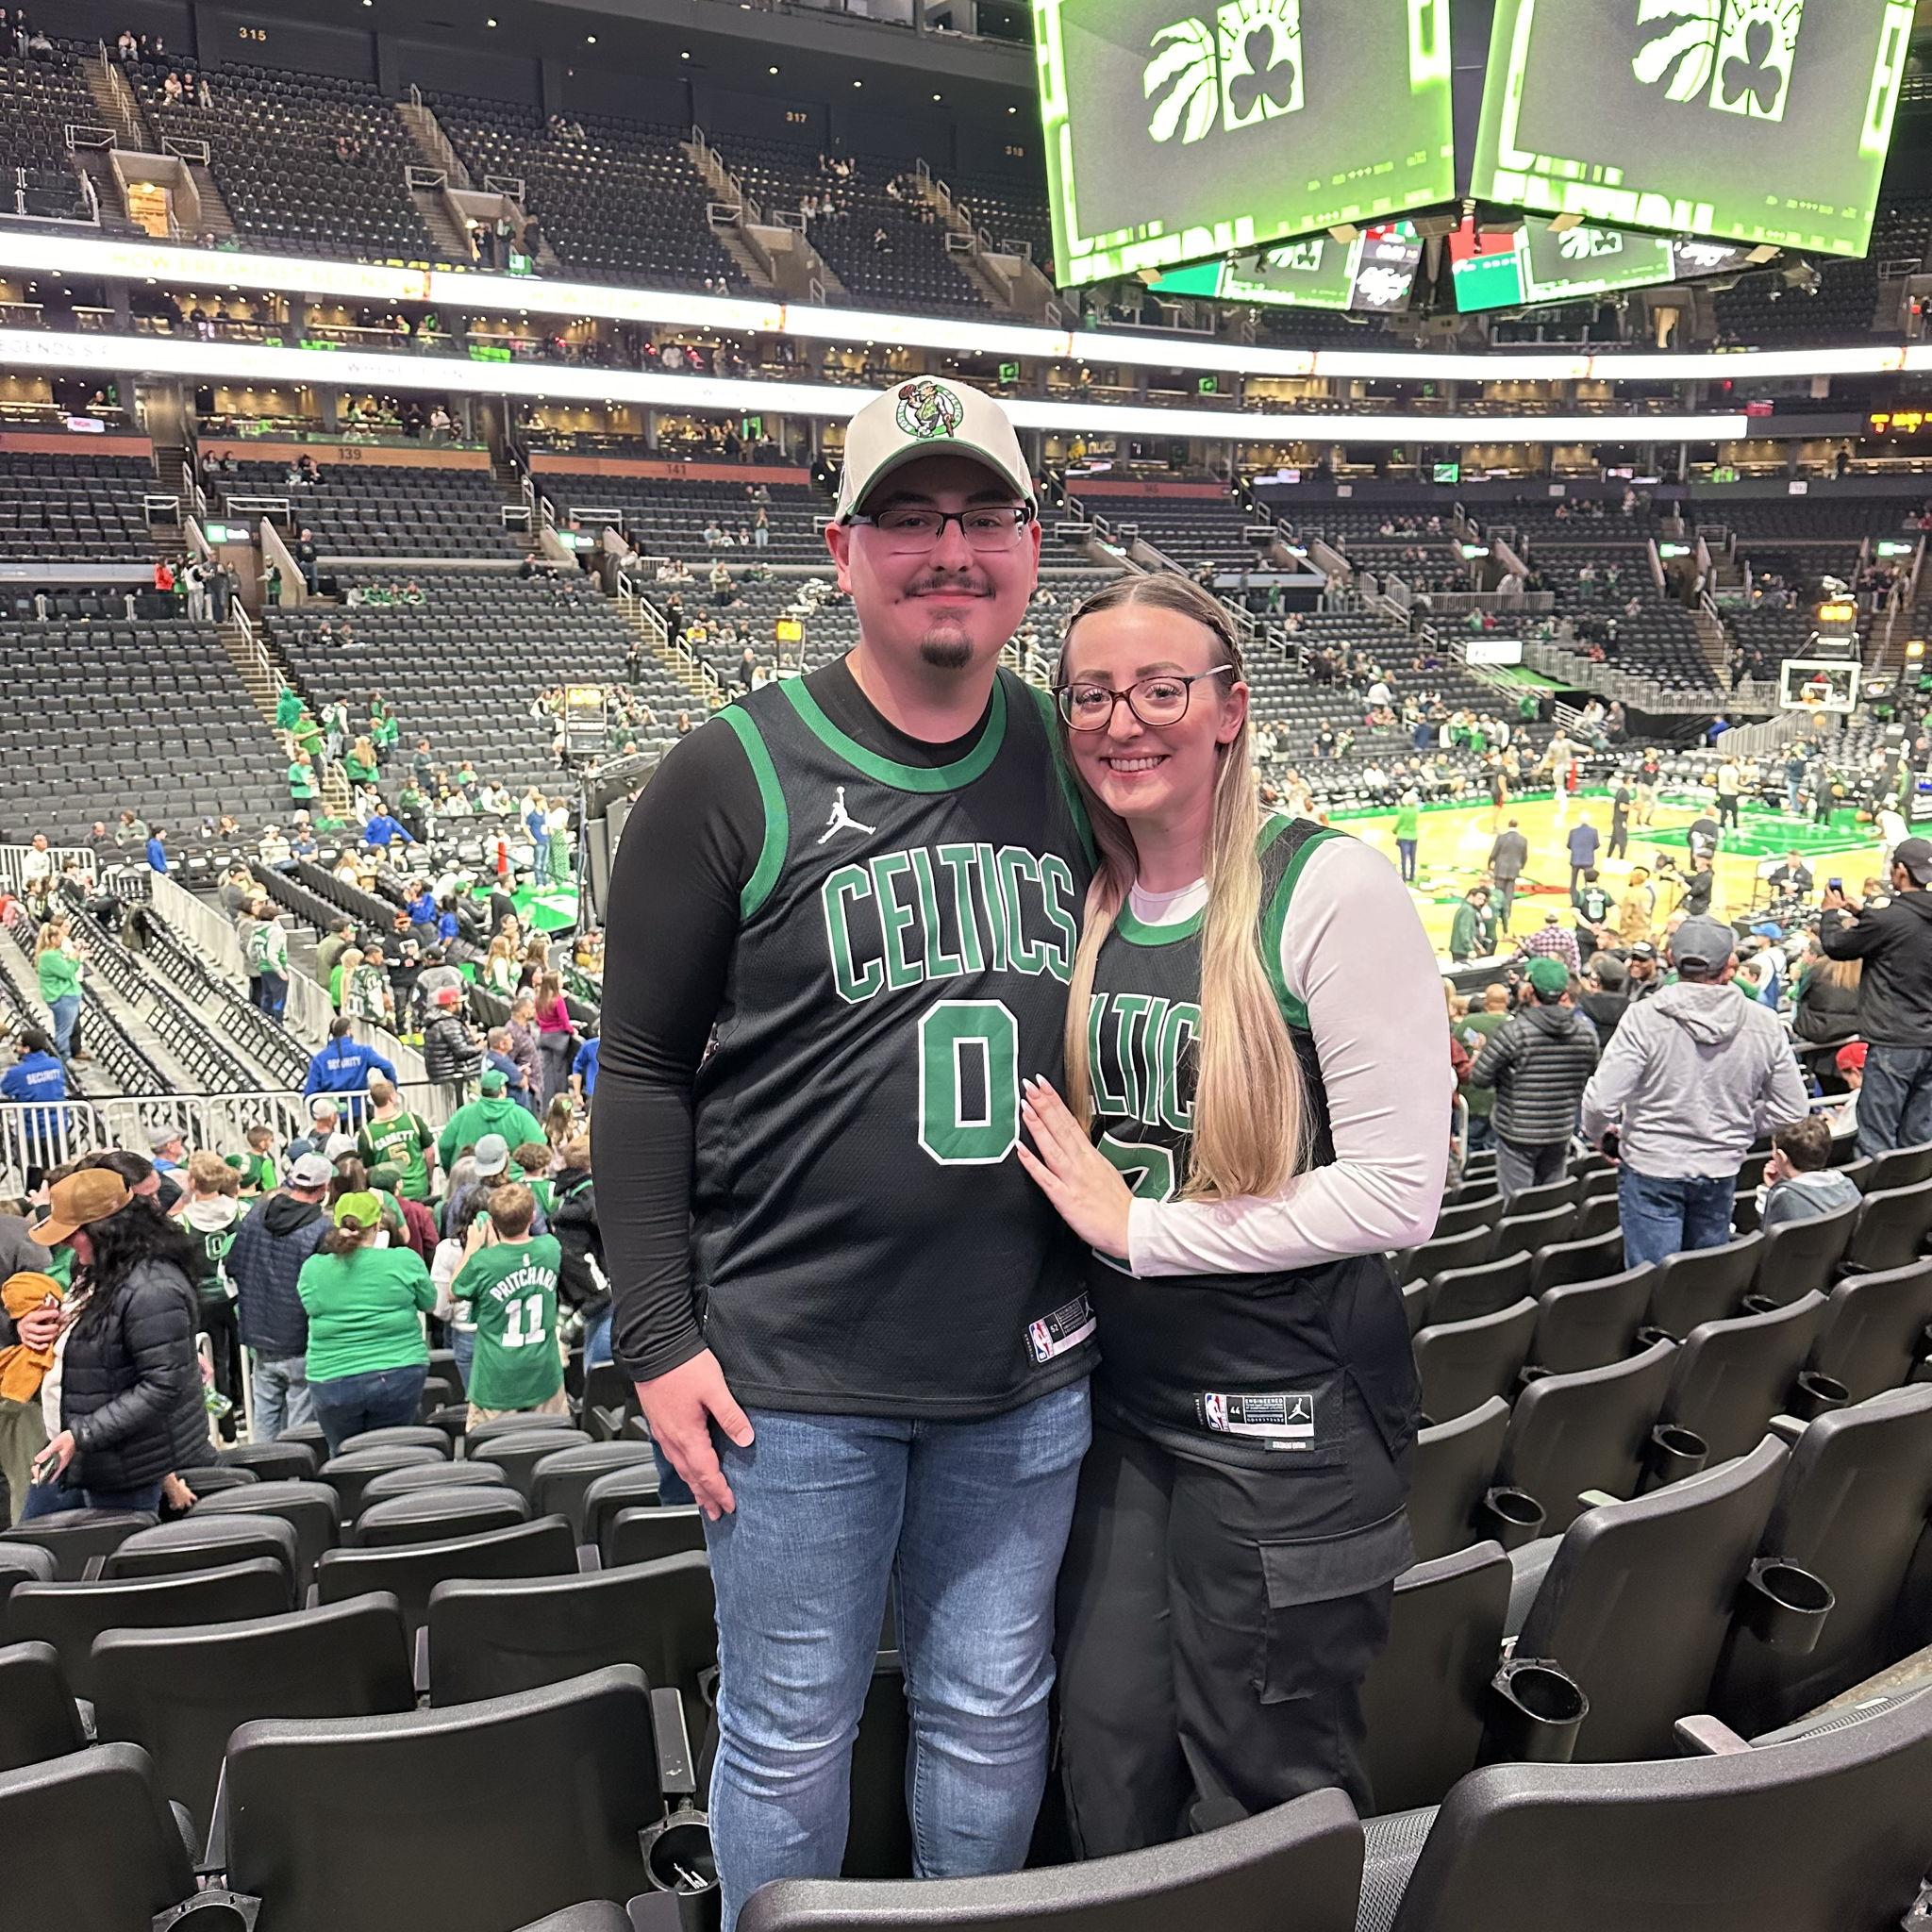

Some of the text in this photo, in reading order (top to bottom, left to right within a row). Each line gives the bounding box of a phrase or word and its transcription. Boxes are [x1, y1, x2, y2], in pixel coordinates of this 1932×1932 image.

[240, 27, 266, 41] 315
[786, 111, 808, 123] 317
[339, 447, 362, 460] 139
[821, 842, 1076, 1004] CELTICS
[25, 1068, 60, 1086] SECURITY
[918, 999, 1021, 1165] 0
[387, 1141, 411, 1166] 5
[501, 1293, 546, 1347] 11
[1229, 1406, 1241, 1415] 44
